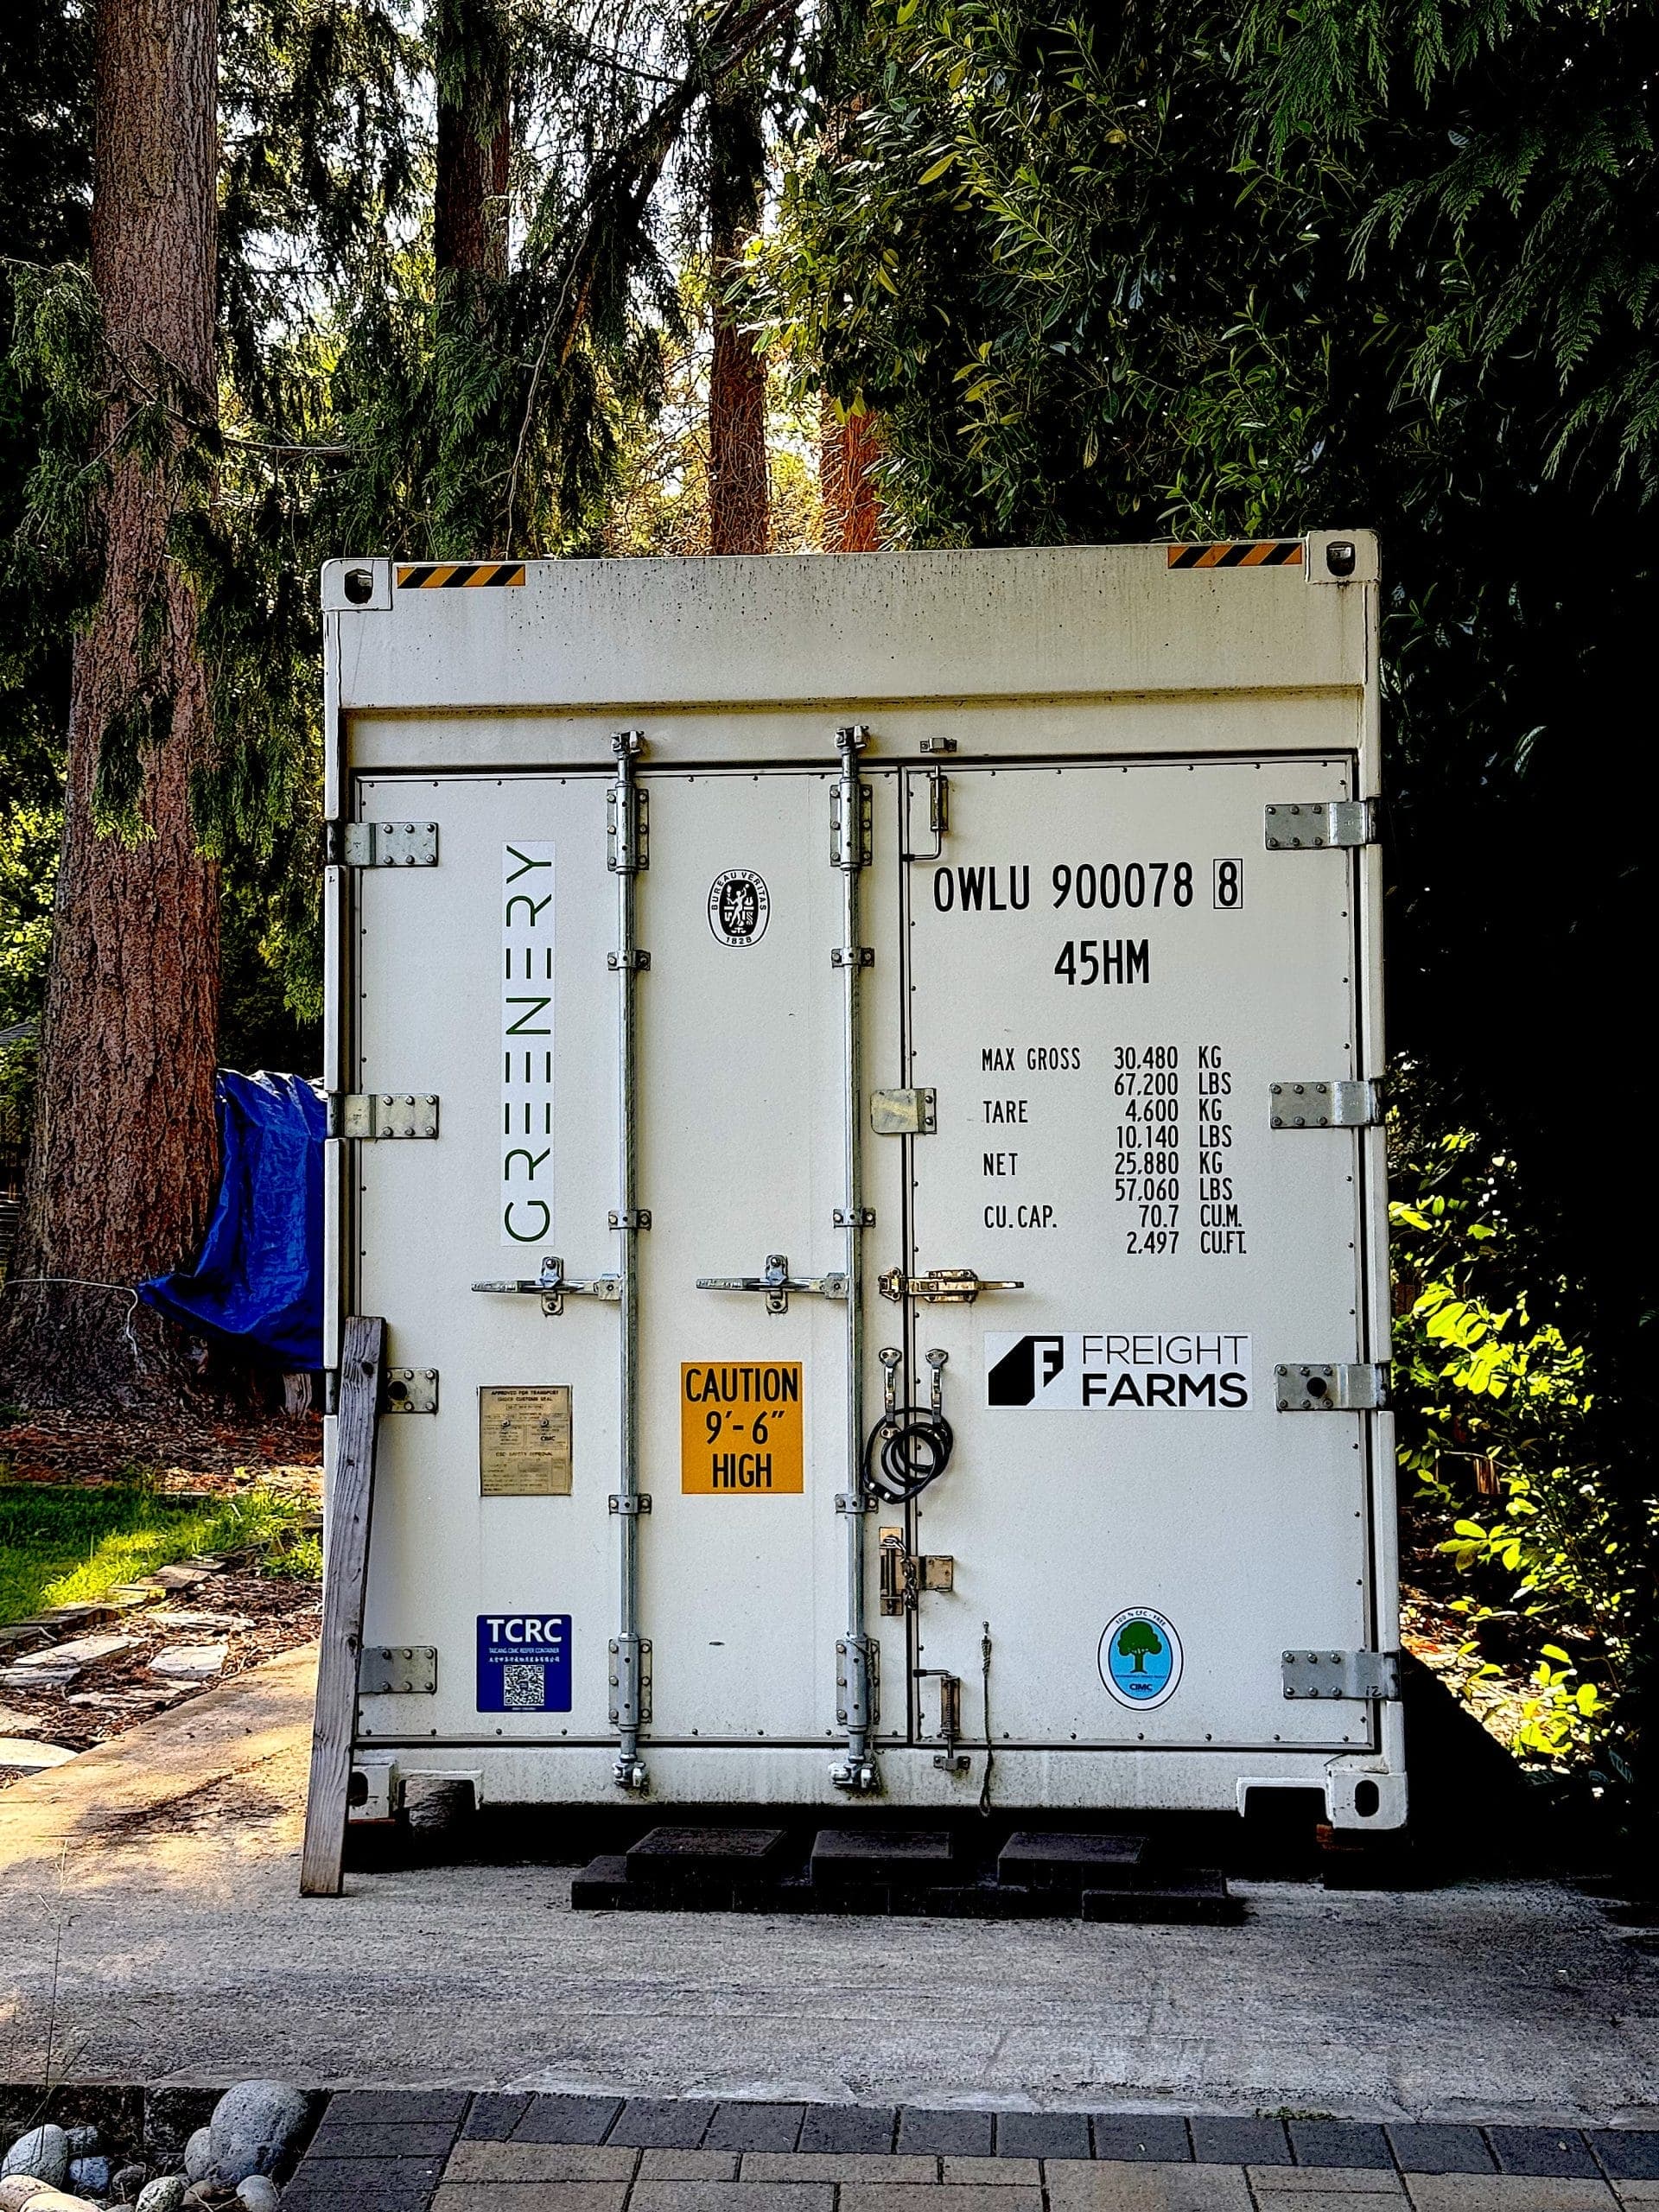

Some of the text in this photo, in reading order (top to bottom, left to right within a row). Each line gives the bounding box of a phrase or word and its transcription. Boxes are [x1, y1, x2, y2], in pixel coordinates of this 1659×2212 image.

[711, 872, 766, 910] BUREAU VERITAS
[934, 861, 1237, 912] OWLU 900078 8
[1055, 939, 1148, 985] 45HM
[505, 846, 551, 1242] GREENERY
[982, 1046, 1221, 1071] MAX GROSS 30,480 KG
[1115, 1072, 1231, 1096] 67,200 LBS
[983, 1098, 1221, 1123] TARE 4,600 KG
[1117, 1125, 1231, 1148] 10,140 LBS
[984, 1151, 1222, 1176] NET 25,880 KG
[1116, 1178, 1232, 1201] 57,060 LBS
[1139, 1205, 1179, 1227] 70.7
[1201, 1205, 1242, 1227] CU.M.
[1127, 1231, 1246, 1254] 2,497 CU.FT.
[1084, 1336, 1248, 1364] FREIGHT
[686, 1368, 798, 1402] CAUTION
[1083, 1373, 1248, 1408] FARMS
[713, 1453, 772, 1487] HIGH
[486, 1618, 562, 1643] TCRC
[1129, 1683, 1153, 1692] CIMC
